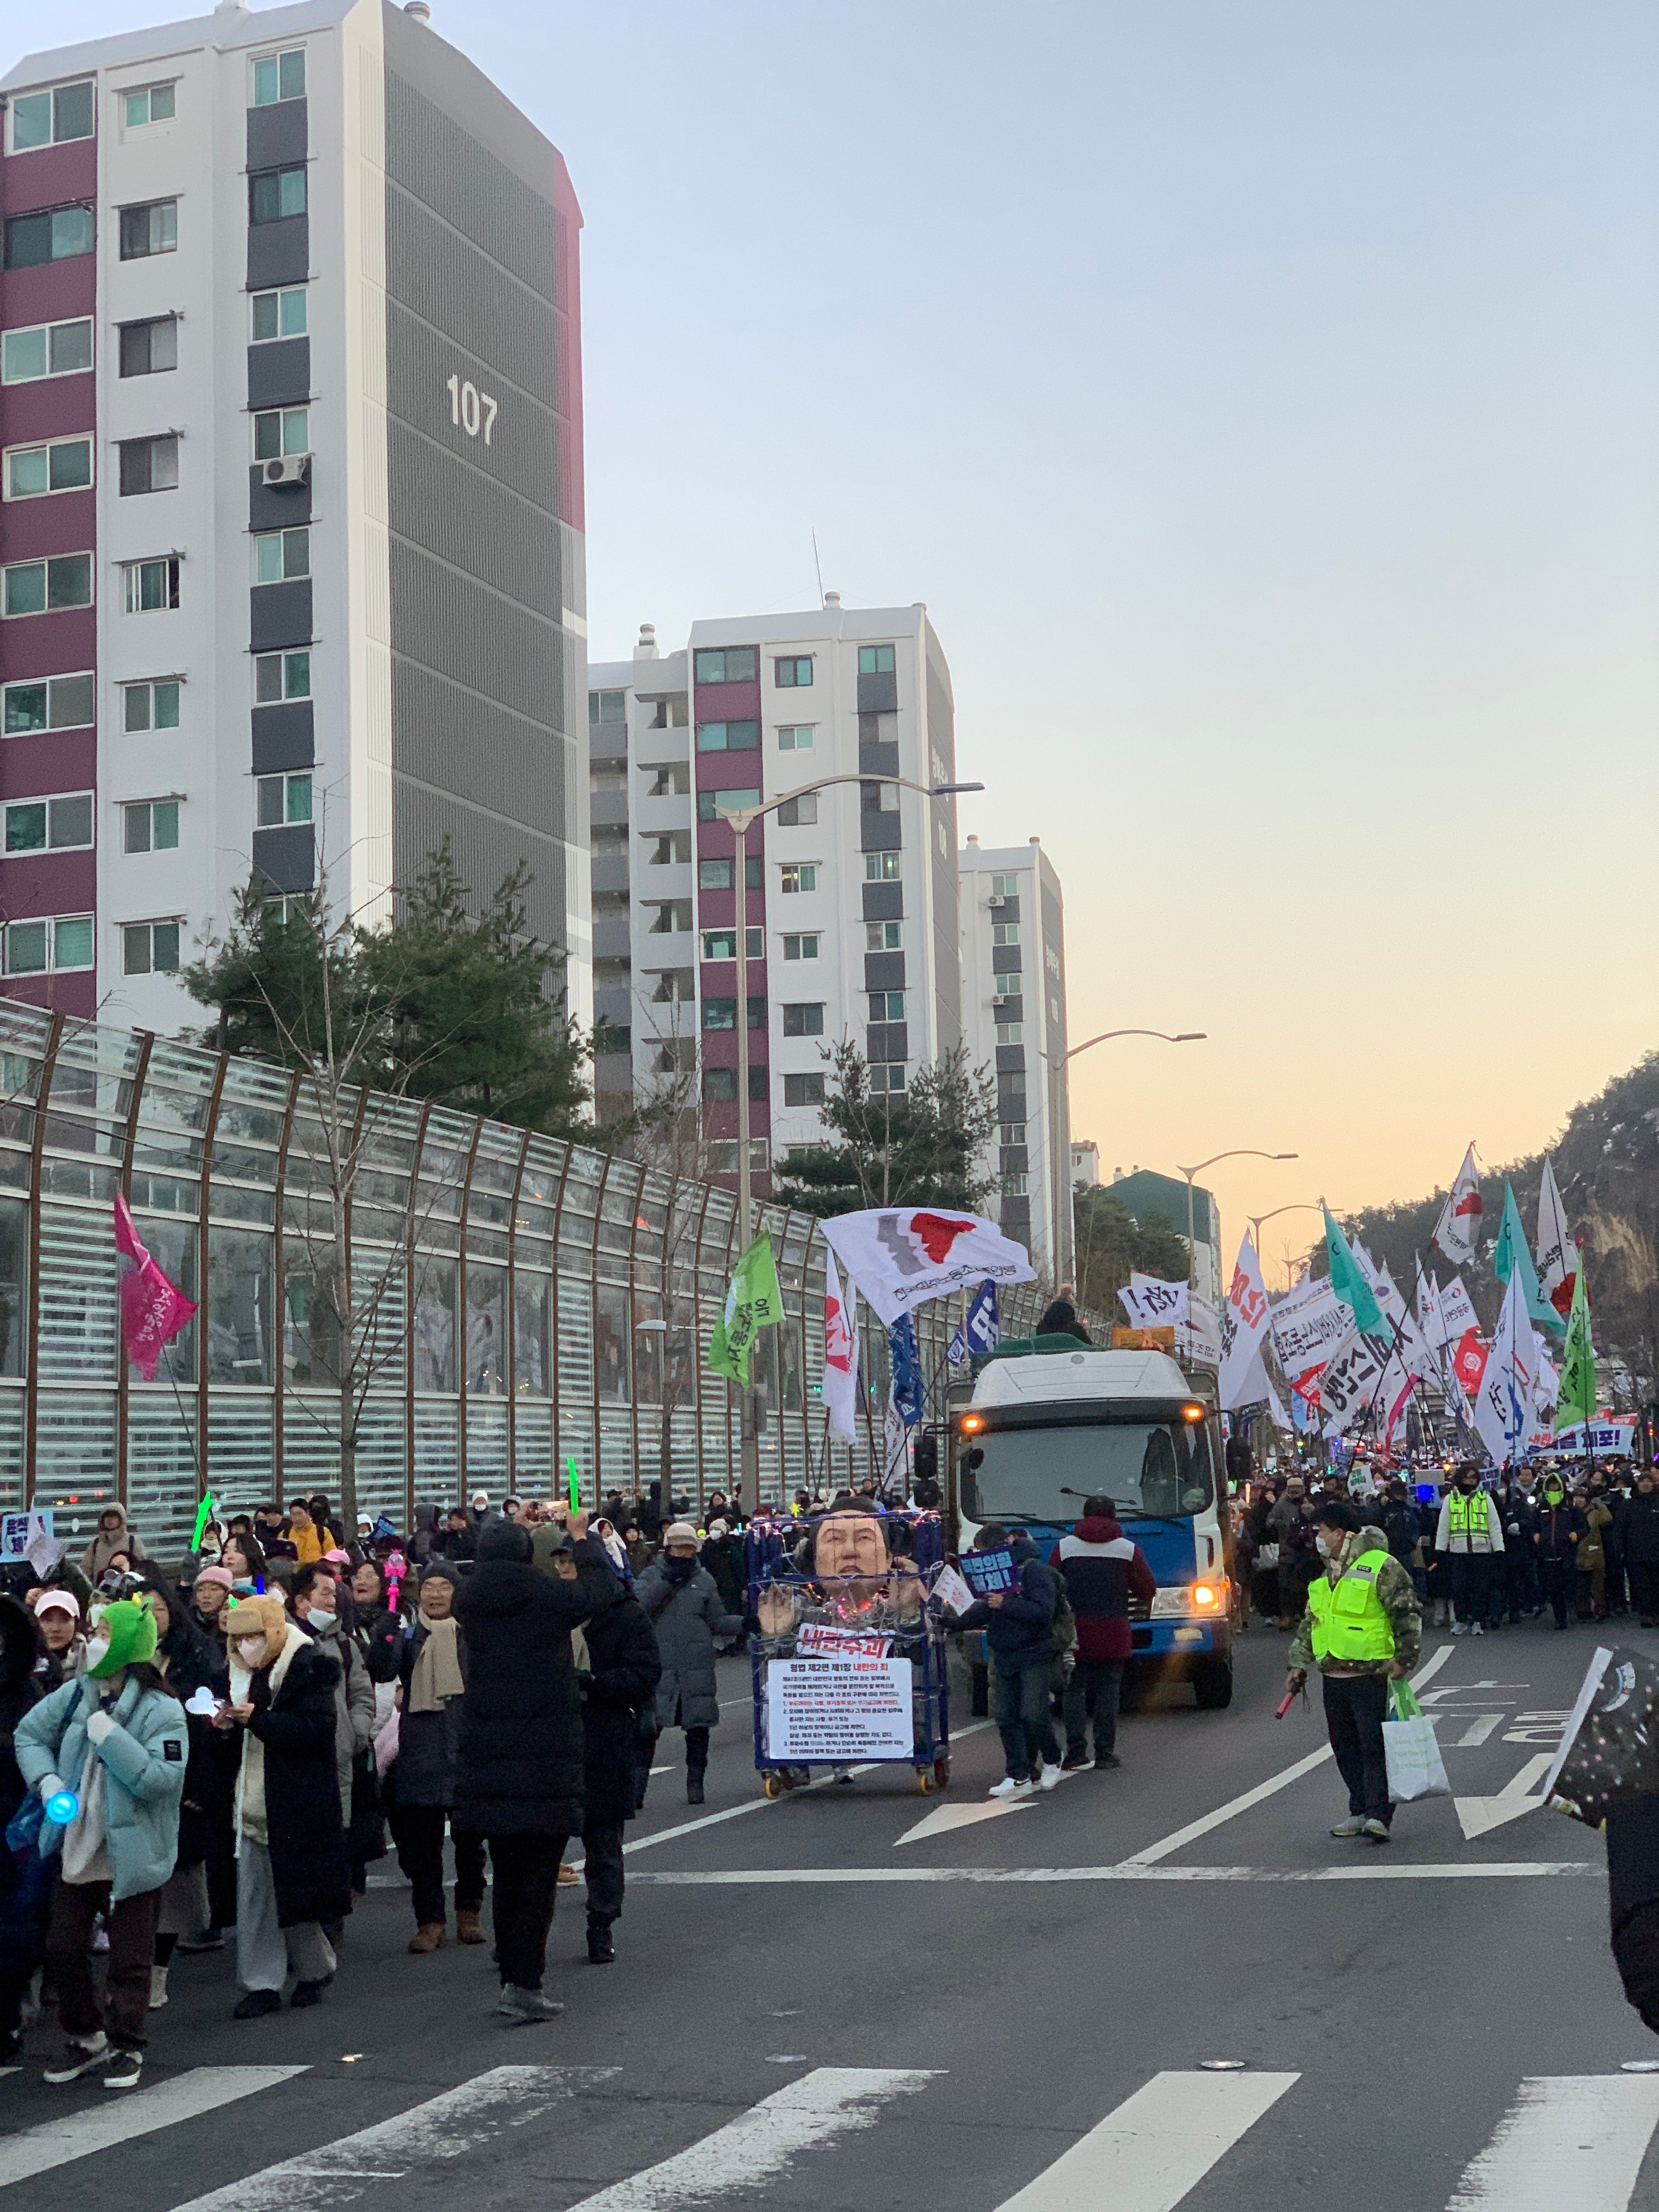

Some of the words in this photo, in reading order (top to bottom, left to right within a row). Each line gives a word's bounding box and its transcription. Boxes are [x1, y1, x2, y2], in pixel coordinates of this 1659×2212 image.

[447, 373, 498, 445] 107
[802, 1628, 888, 1659] 내란수괴
[808, 1663, 829, 1672] 제2편
[831, 1663, 851, 1672] 제1장
[853, 1663, 878, 1672] 내란의
